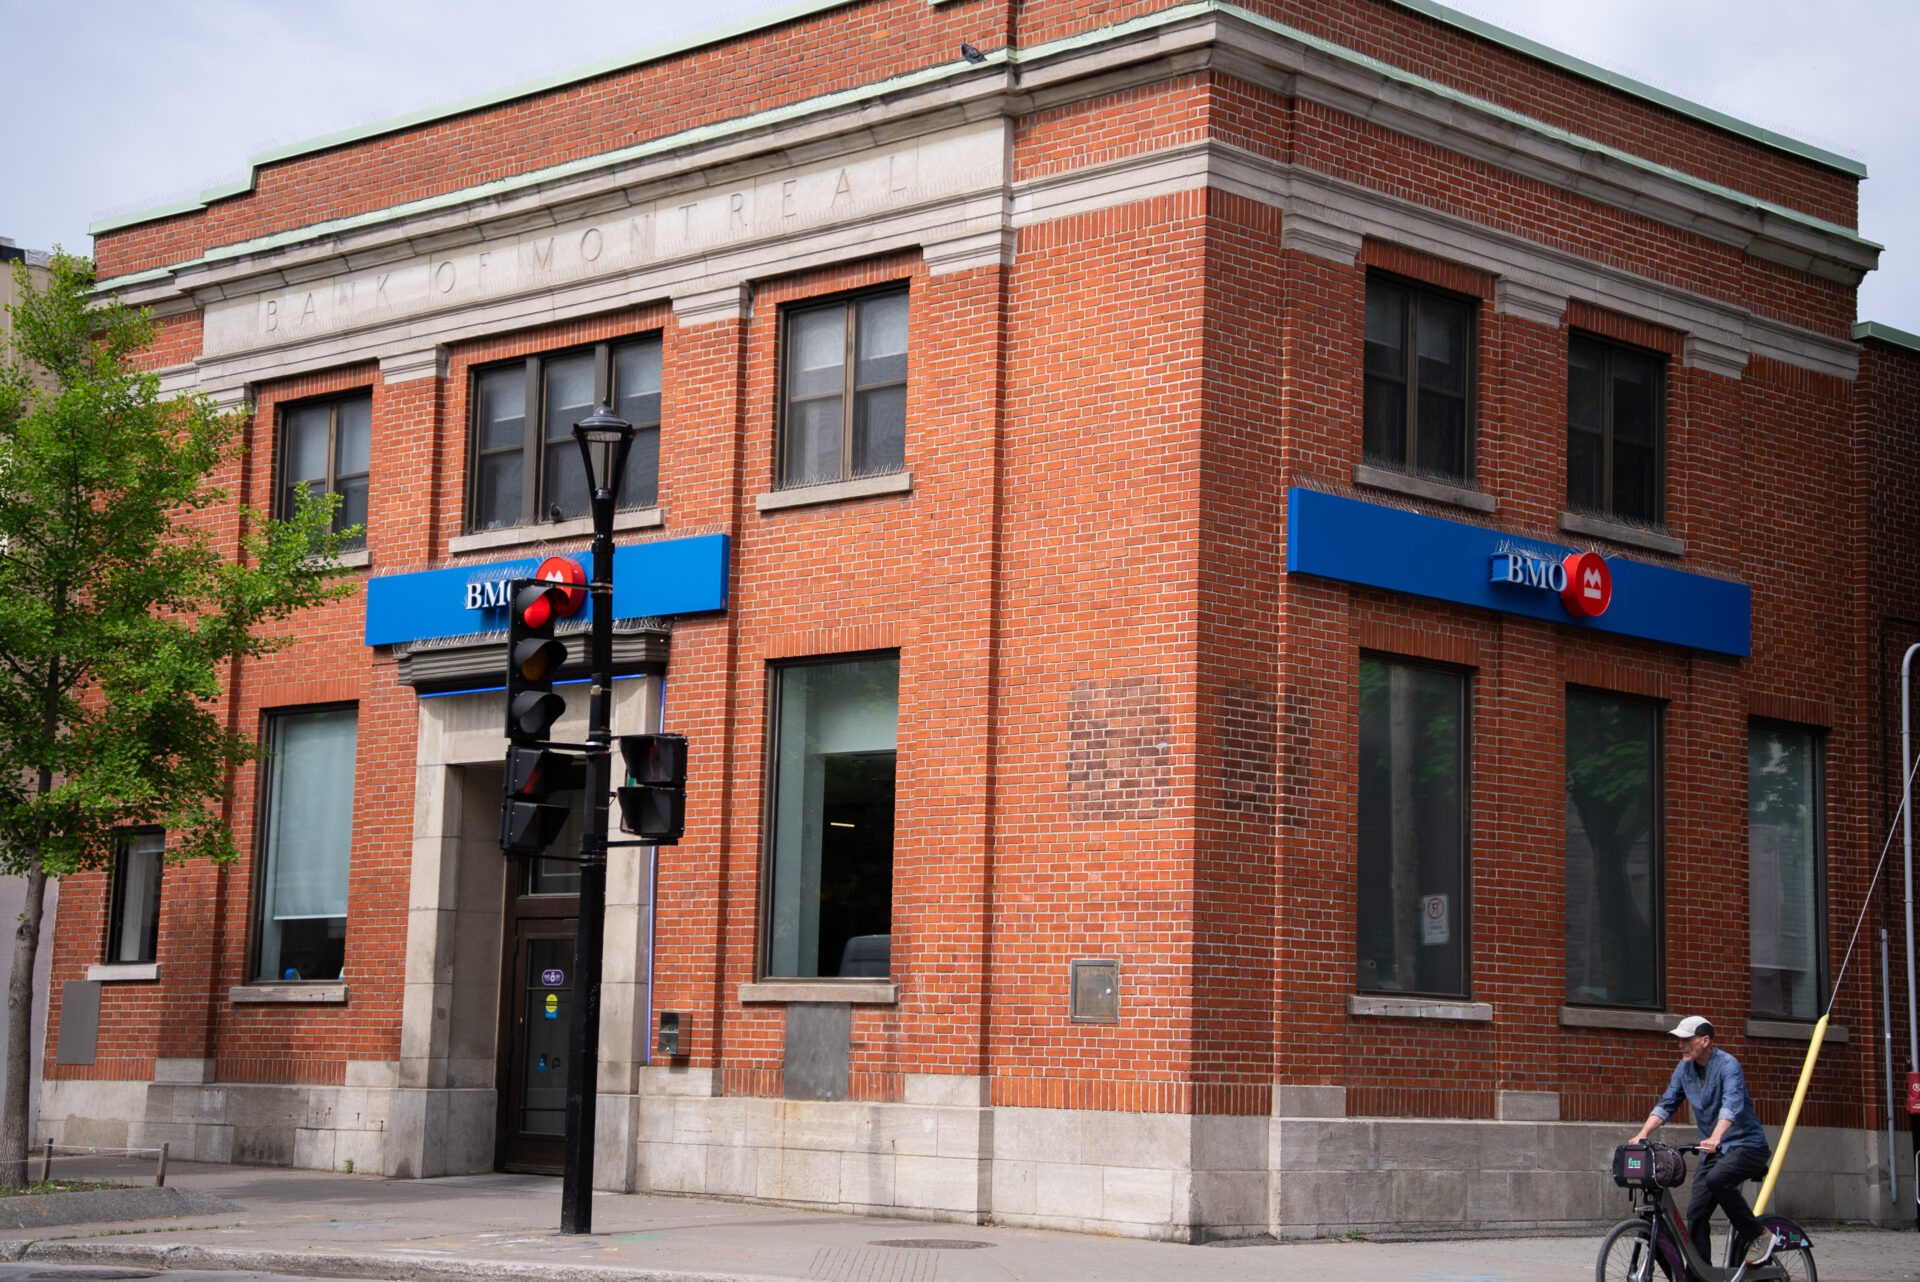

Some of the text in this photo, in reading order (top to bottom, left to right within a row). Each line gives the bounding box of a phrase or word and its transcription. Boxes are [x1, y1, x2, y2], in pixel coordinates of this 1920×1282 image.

[266, 155, 906, 332] BANK OF MONTREAL
[1508, 553, 1567, 592] BMO
[465, 580, 511, 610] BM
